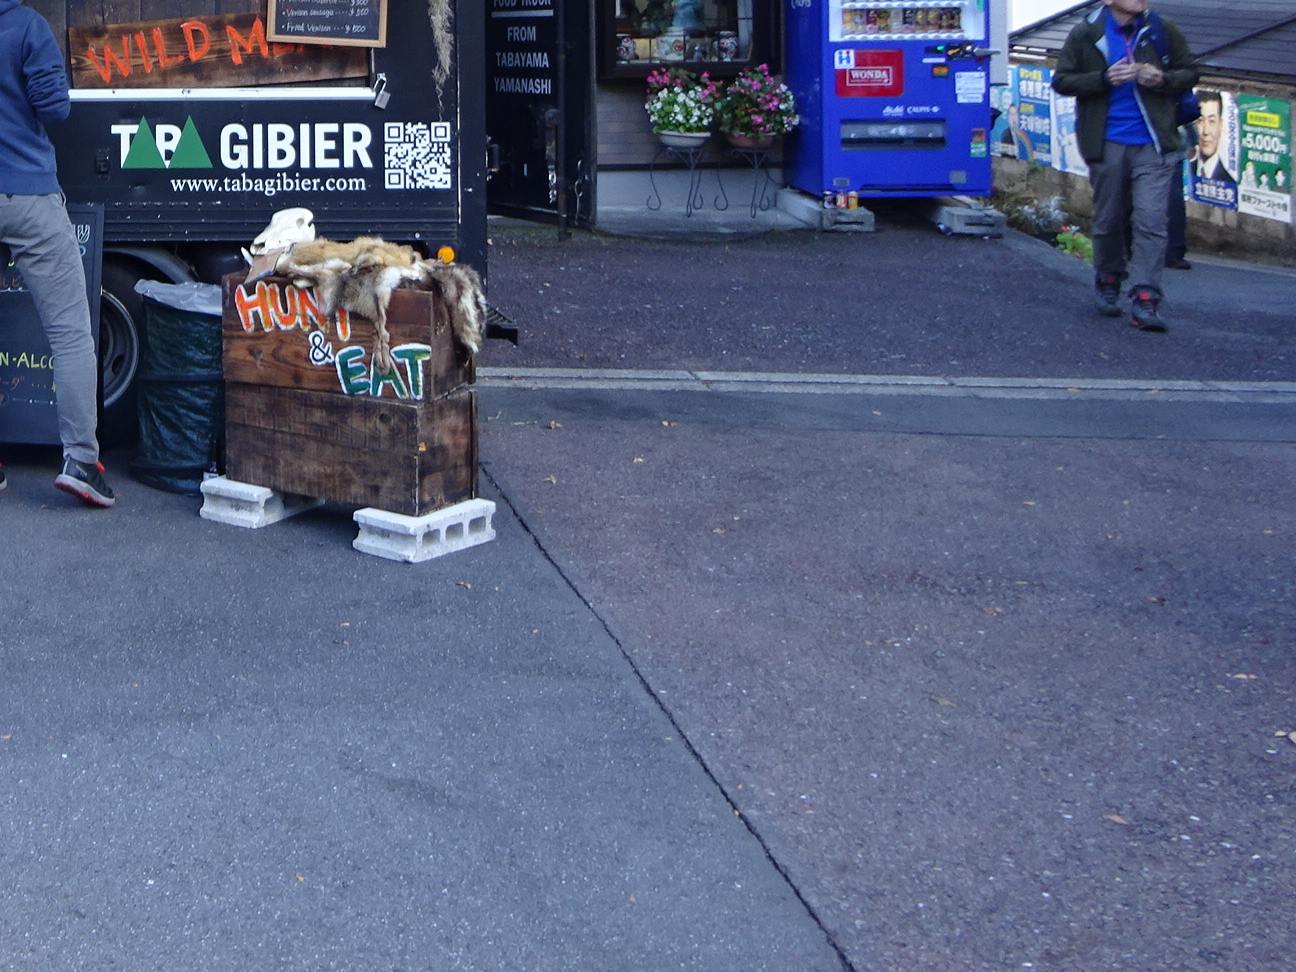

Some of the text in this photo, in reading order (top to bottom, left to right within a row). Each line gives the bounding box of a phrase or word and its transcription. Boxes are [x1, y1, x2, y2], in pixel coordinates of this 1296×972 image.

[507, 26, 536, 42] FROM
[85, 19, 211, 84] WILD
[496, 52, 549, 68] TABAYAMA
[494, 77, 551, 95] YAMANASHI
[850, 70, 888, 79] WONDA
[220, 123, 373, 169] GIBIER
[170, 173, 367, 196] www.tabagibier.com
[308, 330, 334, 365] &
[335, 343, 432, 401] EAT
